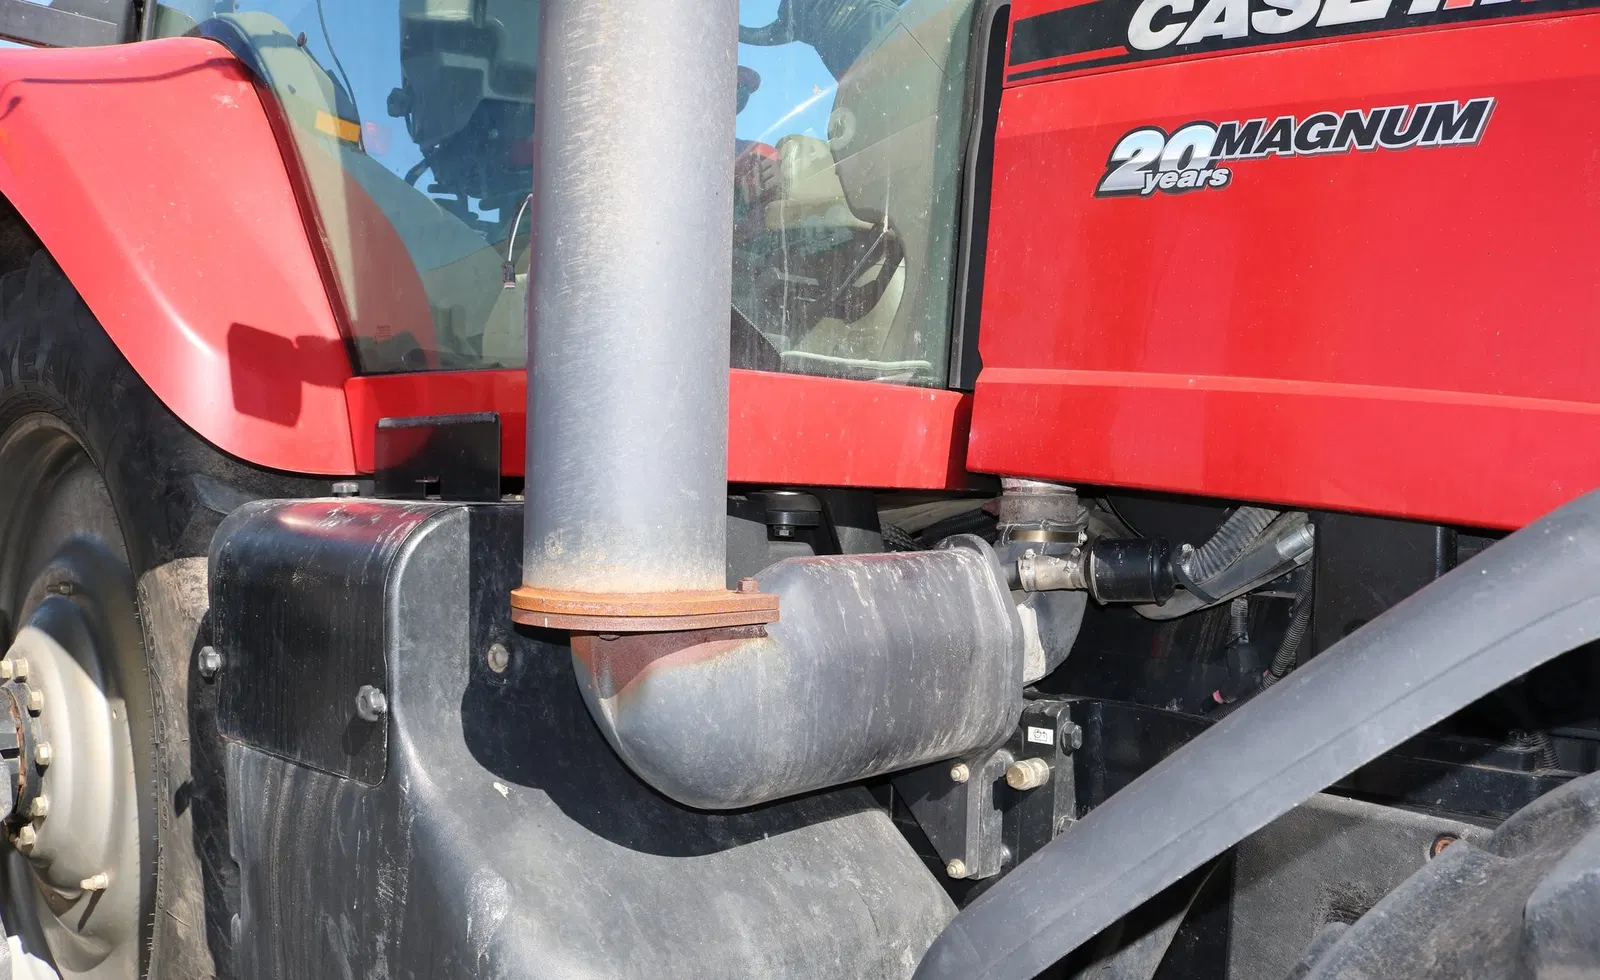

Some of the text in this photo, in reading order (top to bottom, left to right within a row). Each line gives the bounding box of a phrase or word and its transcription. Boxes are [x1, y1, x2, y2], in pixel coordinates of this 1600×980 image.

[1097, 97, 1495, 194] 20 MAGNUM
[1141, 168, 1230, 194] years
